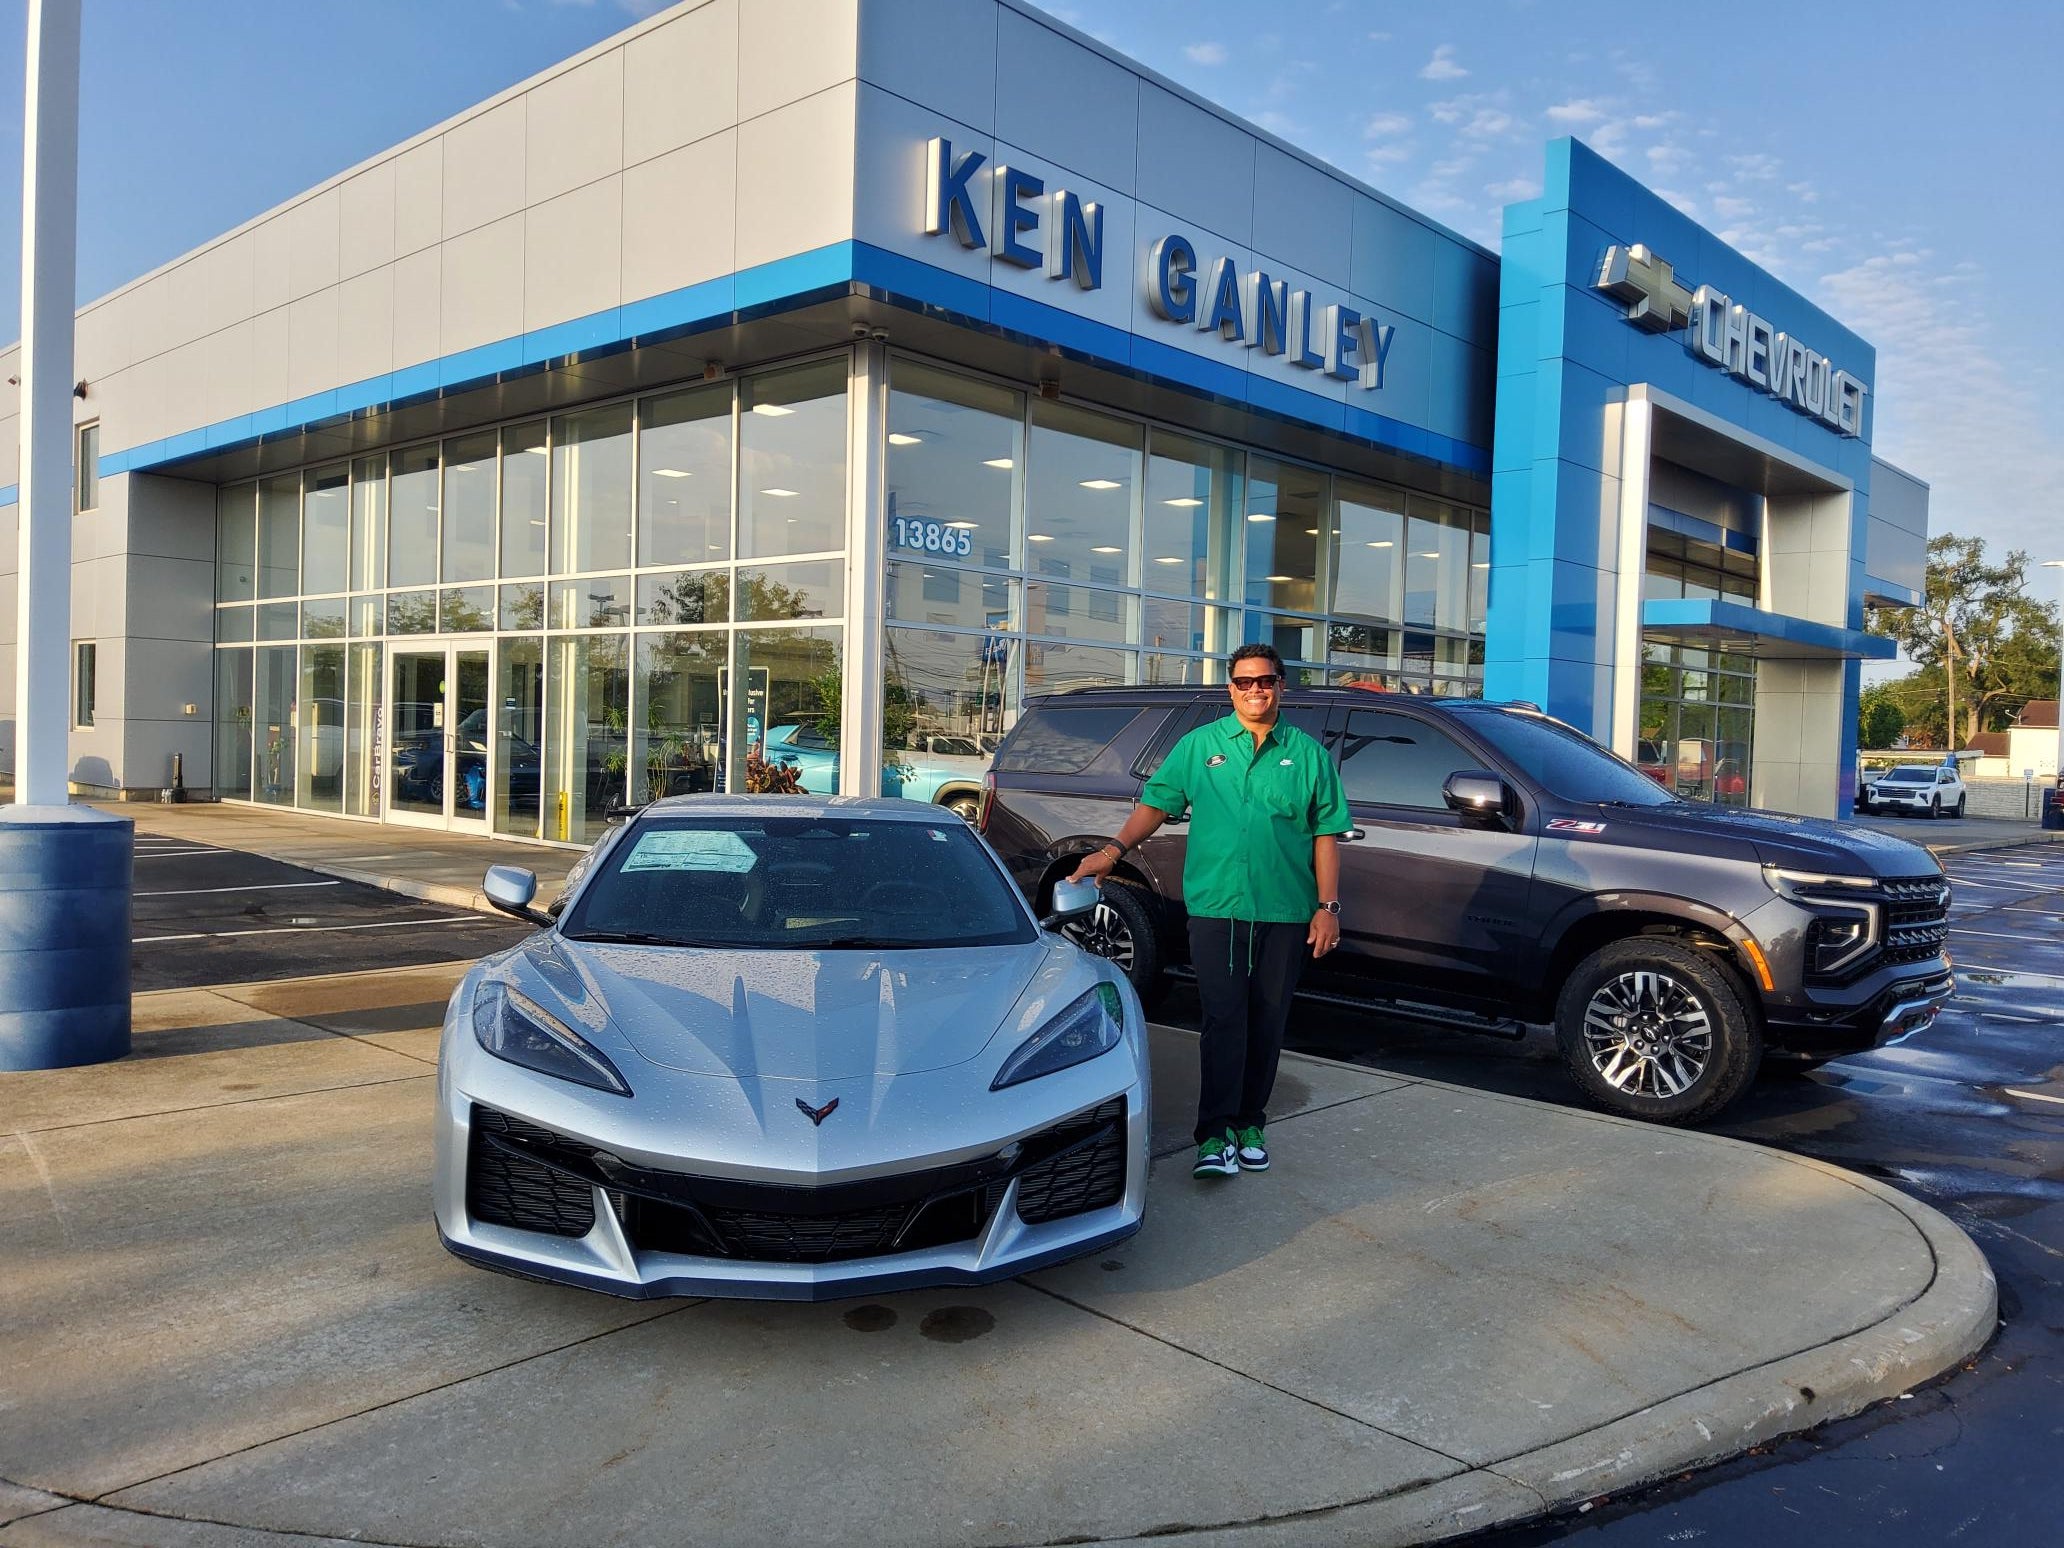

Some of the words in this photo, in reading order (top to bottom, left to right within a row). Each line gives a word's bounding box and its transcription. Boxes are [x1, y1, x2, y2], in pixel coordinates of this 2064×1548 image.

[925, 137, 1104, 290] KEN
[1147, 234, 1395, 389] GANLEY
[1692, 284, 1868, 438] CHEVROLET
[895, 518, 971, 555] 13865
[1545, 819, 1607, 834] Z71
